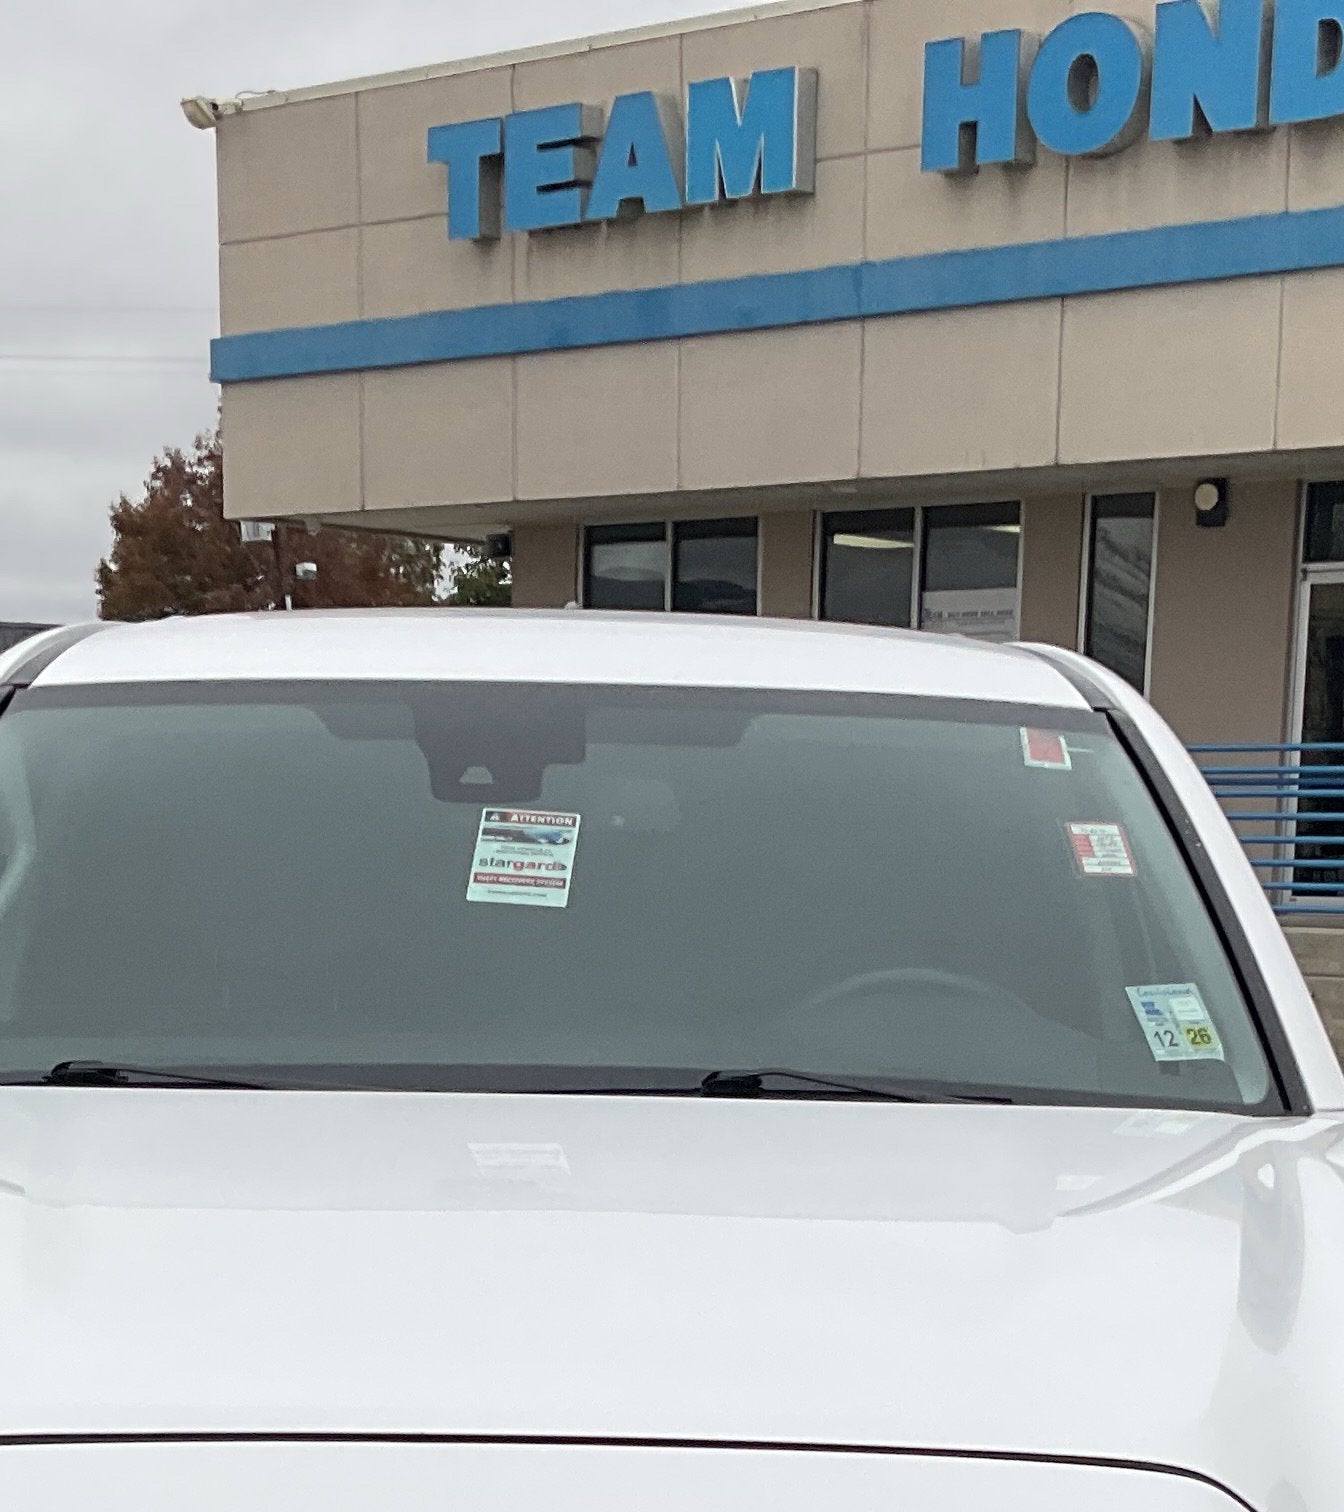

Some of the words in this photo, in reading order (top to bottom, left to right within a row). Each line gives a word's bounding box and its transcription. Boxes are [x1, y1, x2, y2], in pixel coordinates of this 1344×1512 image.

[427, 66, 802, 240] TEAM
[510, 813, 573, 826] ATTENTION
[1154, 1030, 1179, 1047] 12
[1186, 1027, 1212, 1045] 26
